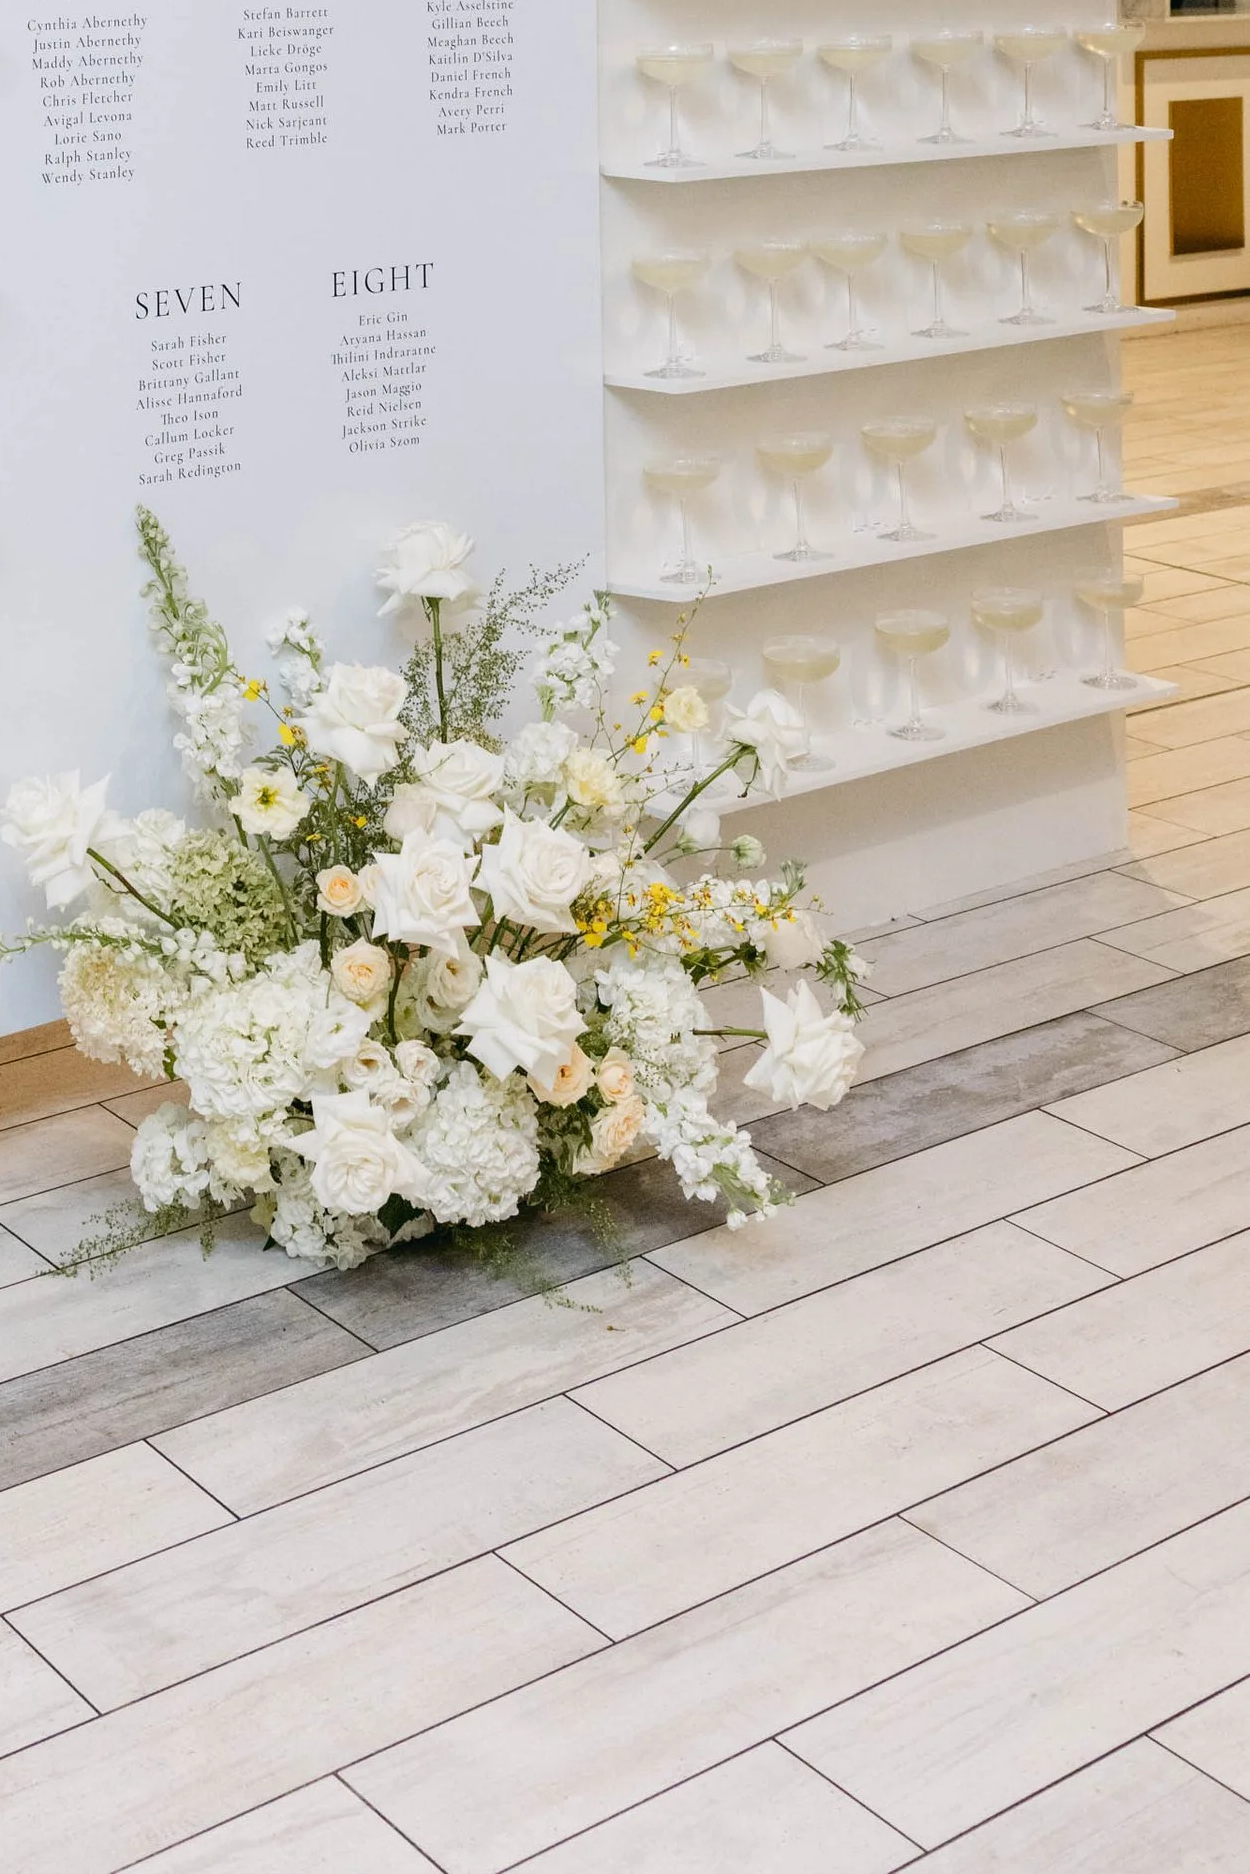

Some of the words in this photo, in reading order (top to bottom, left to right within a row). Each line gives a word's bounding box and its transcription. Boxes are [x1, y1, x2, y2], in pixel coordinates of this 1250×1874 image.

[243, 7, 281, 21] Stefan
[286, 7, 328, 19] Barrett
[427, 0, 452, 16] Kyle
[27, 17, 77, 35] Cynthia
[82, 13, 148, 30] Abernethy
[431, 17, 471, 30] Gillian
[238, 27, 263, 39] Kari
[269, 26, 334, 39] Beiswanger
[32, 38, 71, 54] Justin
[76, 32, 141, 49] Abernethy
[251, 43, 282, 57] Lieke
[427, 34, 477, 51] Meaghan
[32, 55, 73, 72] Maddy
[78, 51, 144, 68] Abernethy
[429, 52, 468, 65] Kaitlin
[245, 64, 280, 76] Marta
[284, 62, 328, 76] Gongos
[431, 69, 468, 83] Daniel
[473, 67, 511, 81] French
[40, 74, 65, 88] Rob
[70, 70, 136, 87] Abernethy
[256, 79, 289, 96] Emily
[295, 79, 317, 91] Litt
[42, 94, 76, 107] Chris
[82, 90, 133, 105] Fletcher
[429, 87, 470, 100] Kendra
[475, 84, 513, 98] French
[249, 100, 277, 112] Matt
[282, 95, 324, 110] Russell
[44, 111, 84, 130] Avigal
[438, 107, 472, 120] Avery
[246, 116, 273, 130] Nick
[437, 121, 466, 135] Mark
[471, 122, 507, 133] Porter
[92, 130, 122, 142] Sano
[246, 134, 275, 149] Reed
[279, 131, 327, 146] Trimble
[45, 149, 81, 168] Ralph
[86, 146, 131, 163] Stanley
[42, 169, 84, 186] Wendy
[89, 165, 135, 182] Stanley
[331, 262, 434, 298] EIGHT
[135, 281, 242, 320] SEVEN
[359, 314, 382, 326] Eric
[386, 312, 408, 323] Gin
[151, 336, 185, 352] Sarah
[190, 332, 227, 348] Fisher
[340, 335, 382, 349] Aryana
[386, 329, 427, 341] Hassan
[152, 359, 184, 371] Scott
[189, 351, 226, 366] Fisher
[331, 350, 369, 365] Thilini
[139, 377, 189, 391] Brittany
[194, 368, 240, 384] Gallant
[178, 384, 243, 405] Hannaford
[345, 388, 377, 403] Jason
[382, 381, 422, 397] Maggio
[347, 402, 374, 417] Reid
[379, 398, 422, 413] Nielsen
[160, 413, 188, 425] Theo
[194, 410, 219, 421] Ison
[145, 431, 188, 446] Callum
[194, 424, 235, 440] Locker
[342, 421, 387, 440] Jackson
[391, 414, 427, 430] Strike
[154, 452, 184, 465] Greg
[189, 442, 226, 459] Passik
[349, 439, 385, 453] Olivia
[390, 437, 420, 448] Szom
[139, 468, 173, 485] Sarah
[178, 463, 241, 479] Redington
